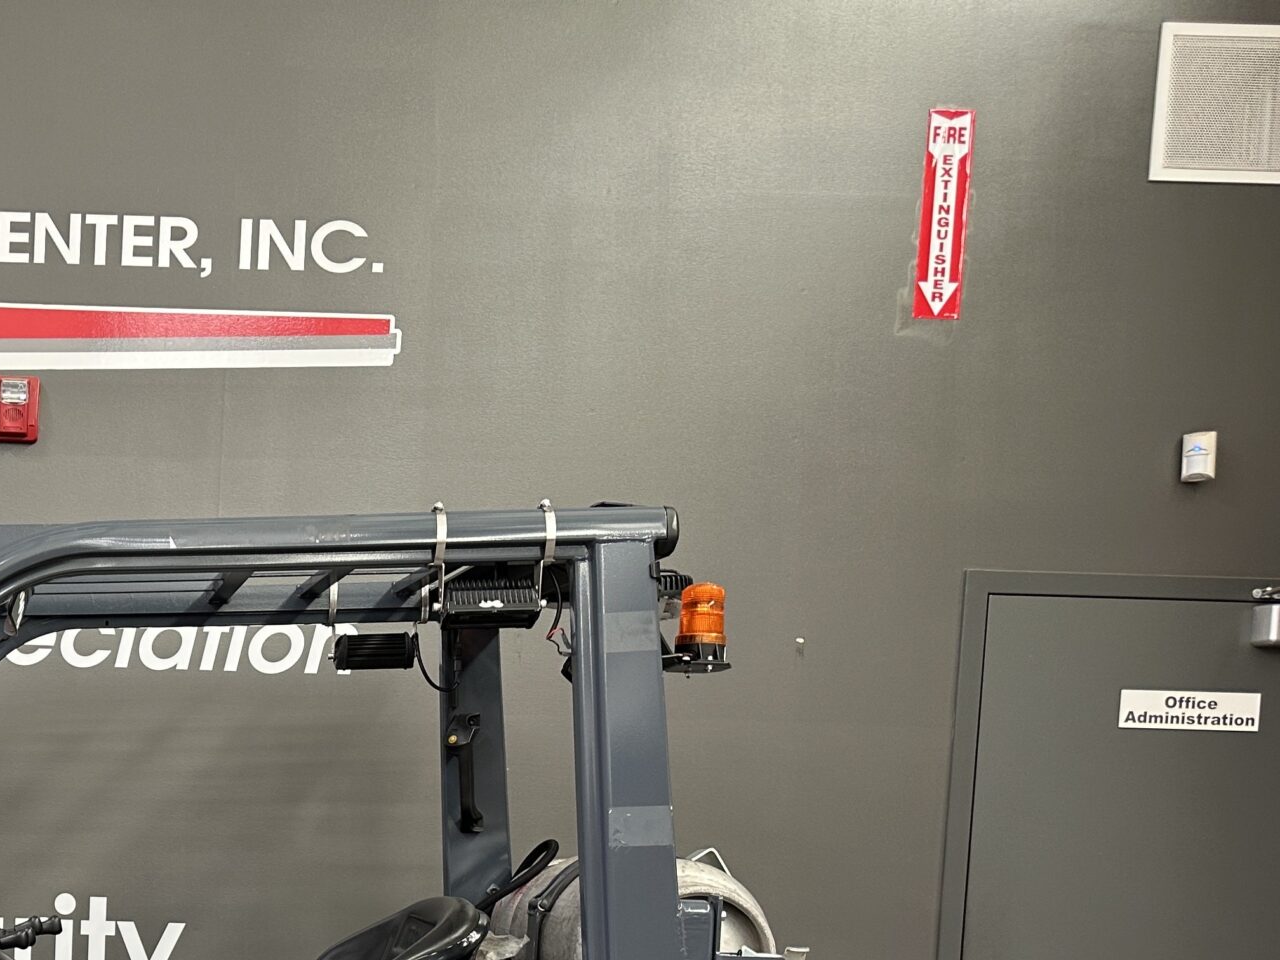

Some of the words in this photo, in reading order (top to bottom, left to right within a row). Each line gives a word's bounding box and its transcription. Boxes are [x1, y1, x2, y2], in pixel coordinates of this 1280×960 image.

[238, 217, 384, 274] INC.
[931, 155, 954, 302] EXTINGUISHER
[1124, 711, 1255, 727] Administration
[1165, 696, 1218, 710] Office
